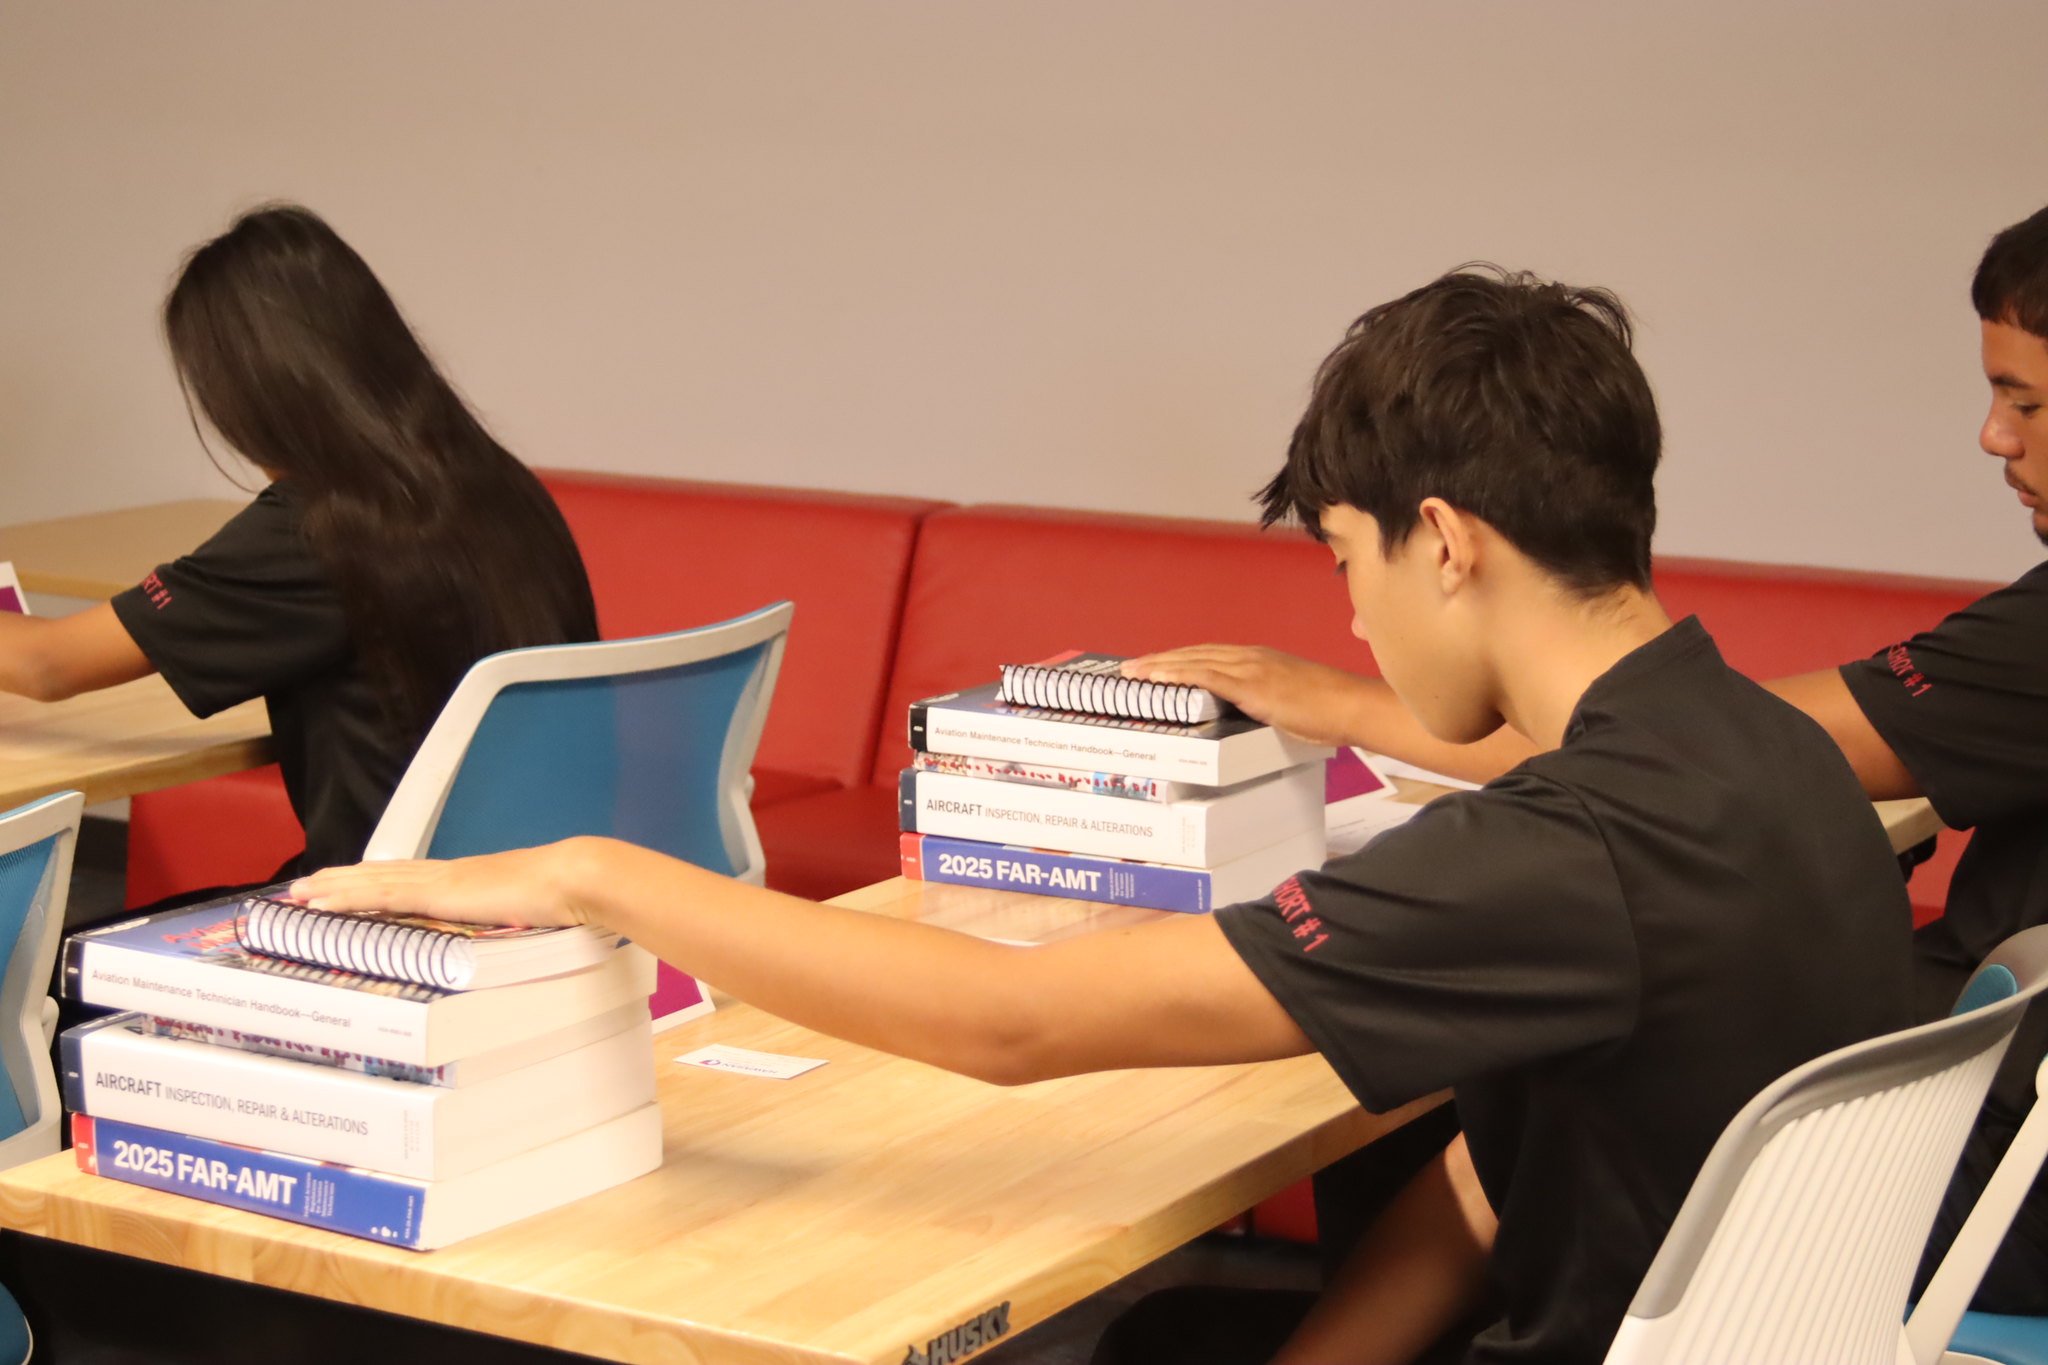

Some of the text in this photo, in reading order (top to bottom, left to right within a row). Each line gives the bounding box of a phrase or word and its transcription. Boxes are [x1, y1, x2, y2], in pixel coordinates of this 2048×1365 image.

[934, 727, 968, 738] Aviation
[970, 731, 1022, 745] Maintenance
[1024, 737, 1068, 750] Technician
[926, 798, 983, 817] AIRCRAFT
[1045, 814, 1078, 829] REPAIR
[1080, 819, 1088, 830] &
[1091, 820, 1153, 838] ALTERATIONS
[938, 853, 994, 880] 2025
[996, 860, 1102, 892] FAR-AMT
[92, 969, 130, 985] Aviation
[132, 977, 192, 998] Maintenance
[196, 988, 247, 1008] Technician
[95, 1071, 368, 1135] AIRCRAFT INSPECTION, REPAIR & ALTERATIONS
[113, 1139, 174, 1178] 2025
[177, 1153, 297, 1205] FAR-AMT
[927, 1300, 1011, 1365] HUSKY
